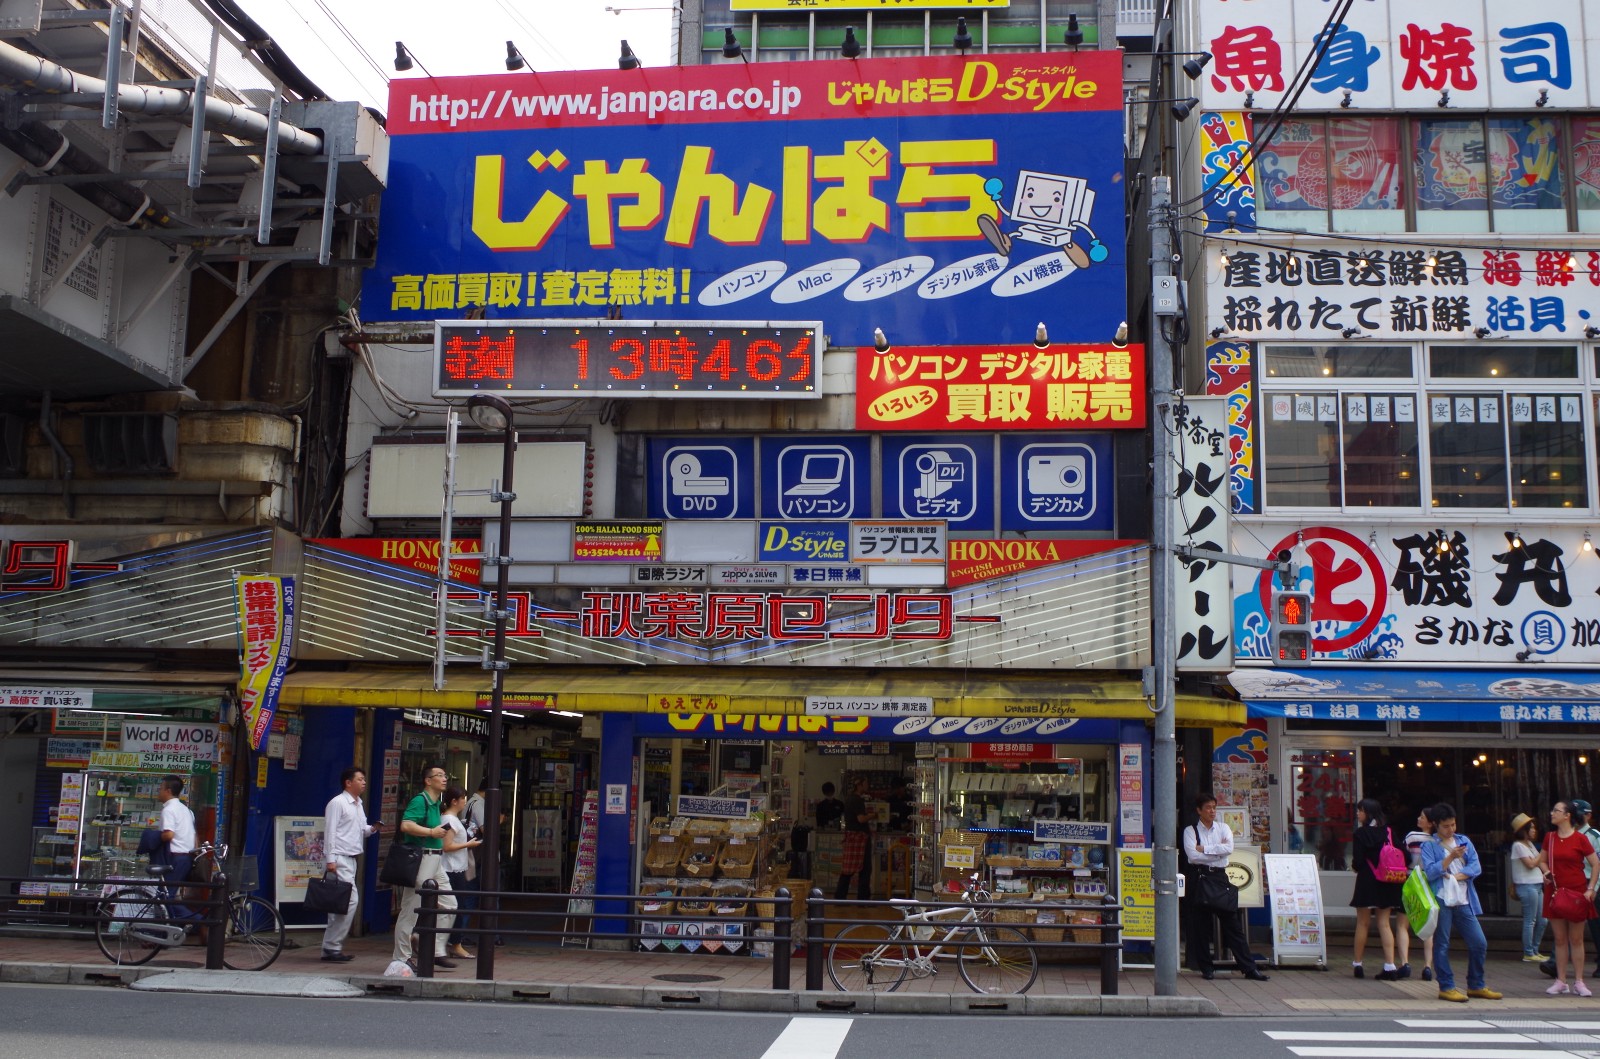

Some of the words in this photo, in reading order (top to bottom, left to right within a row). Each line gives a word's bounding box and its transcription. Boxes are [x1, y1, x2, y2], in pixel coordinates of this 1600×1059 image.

[1210, 25, 1285, 92] 魚
[1310, 22, 1380, 93] 身
[1400, 22, 1478, 91] 焼
[1499, 22, 1572, 90] 司
[1012, 65, 1077, 76] ディー・スタイル
[827, 77, 954, 106] じゃんぱら
[955, 61, 1098, 111] D-Style
[409, 80, 802, 127] http://www.janpara.co.jp
[470, 136, 1000, 253] じゃんぱら
[926, 252, 1001, 295] デジタル家電
[1012, 259, 1065, 289] AV機器
[1223, 249, 1470, 288] 産地直送鮮魚
[1483, 249, 1600, 288] 海鮮
[715, 268, 769, 299] パソコン
[796, 269, 833, 293] Mac
[861, 262, 917, 295] デジカメ
[390, 267, 692, 312] 高価買取!査定無料!
[1223, 295, 1472, 332] 採れたて新鮮
[869, 352, 968, 382] パソコン
[979, 350, 1133, 381] デジタル家電
[873, 388, 935, 417] いろいろ
[945, 383, 1032, 422] 買取
[1046, 381, 1133, 421] 販売
[1172, 403, 1225, 457] 喫茶室
[940, 466, 959, 477] DV
[682, 496, 718, 511] DVD
[786, 497, 847, 514] パソコン
[915, 498, 962, 514] ビデオ
[1030, 496, 1084, 514] デジカメ
[575, 525, 595, 534] 100%
[595, 525, 621, 534] HALAL
[621, 525, 642, 534] FOOD
[642, 525, 663, 534] SHOP
[859, 526, 886, 534] パソコン
[916, 526, 937, 534] 測定器
[763, 525, 846, 558] D-Style
[859, 535, 940, 555] ラブロス
[576, 548, 641, 557] 03-3526-6116
[949, 541, 1061, 561] HONOKA
[448, 562, 480, 577] NGLISH
[637, 567, 706, 581] 国際ラジオ
[721, 570, 748, 579] zippo
[793, 567, 862, 582] 春日無線
[951, 562, 993, 578] ENGLISH
[973, 561, 1026, 580] COMPUTER
[1392, 528, 1573, 608] 磯丸
[1415, 615, 1515, 647] さかな
[43, 696, 84, 706] 買います。
[659, 696, 719, 711] もえでん
[811, 701, 844, 710] ラブロス
[846, 702, 879, 711] パソコン
[882, 702, 899, 711] 携帯
[901, 702, 928, 712] 測定器
[1004, 704, 1039, 714] じゃんぱら
[1038, 701, 1076, 715] D-Style
[1329, 704, 1360, 719] 活貝
[1376, 703, 1421, 719] 浜焼き
[1500, 704, 1564, 721] 磯丸水産
[901, 715, 928, 731] パソコン
[940, 718, 959, 730] Mac
[972, 715, 1000, 731] デジカメ
[126, 726, 170, 742] World
[49, 740, 76, 748] iPhone
[153, 742, 200, 752] 世界のモバイル
[91, 751, 113, 765] World
[115, 753, 140, 767] MOBA
[144, 753, 163, 762] SIM
[166, 754, 192, 763] FREE
[192, 762, 211, 770] フォン
